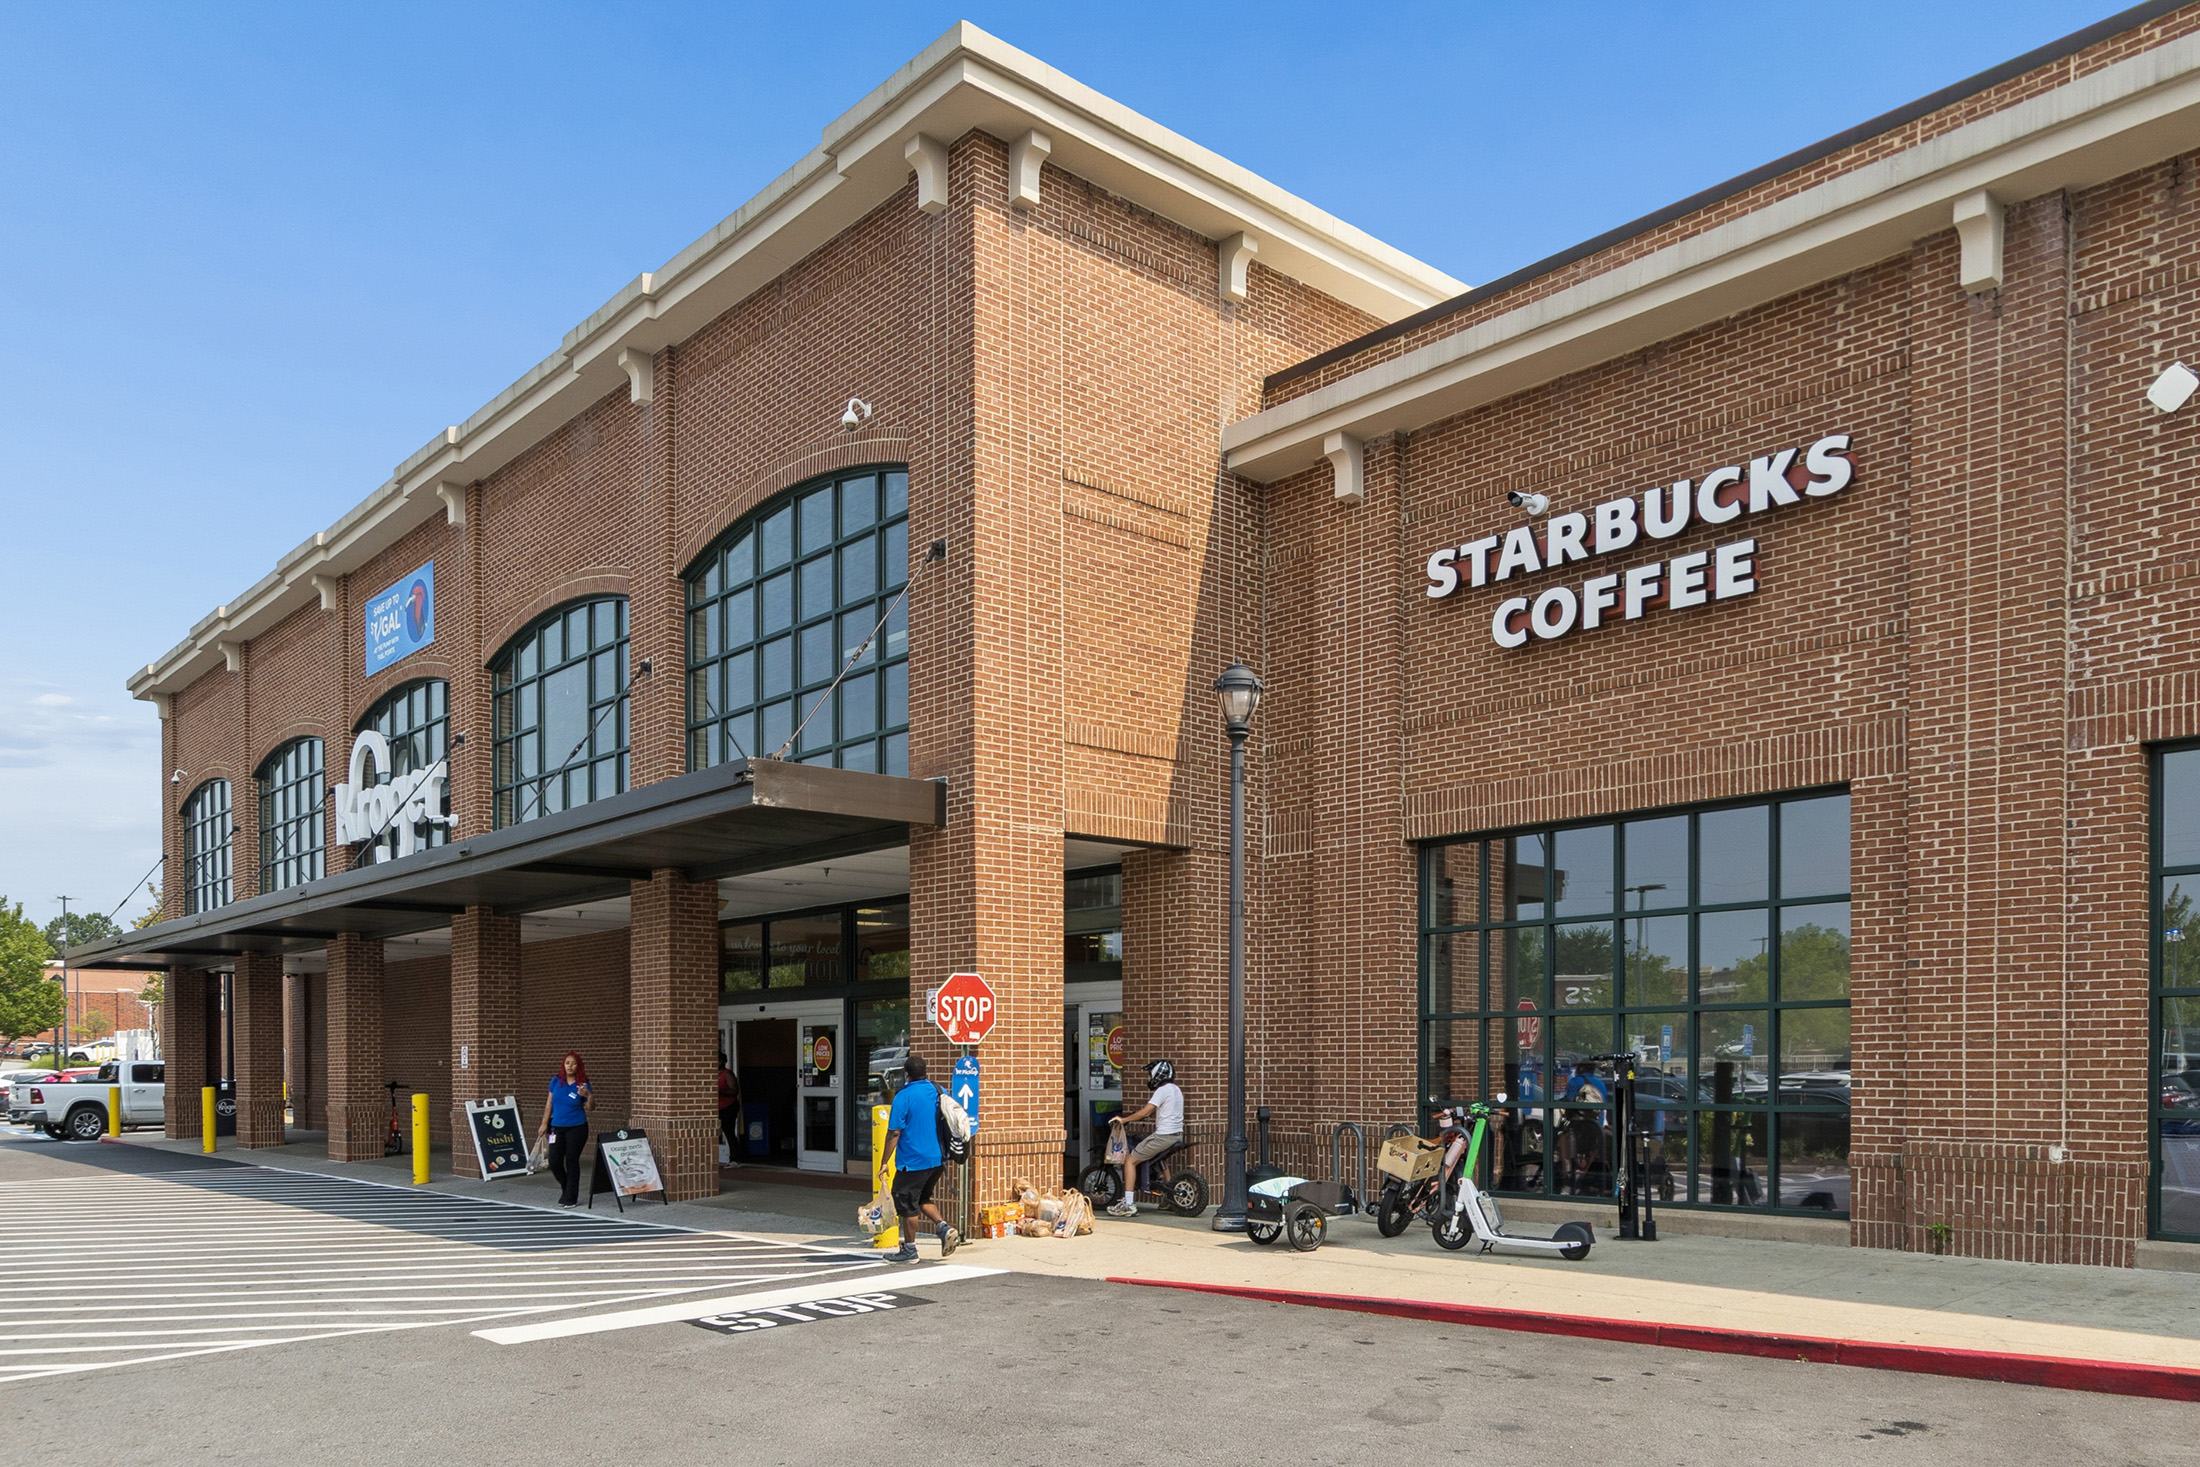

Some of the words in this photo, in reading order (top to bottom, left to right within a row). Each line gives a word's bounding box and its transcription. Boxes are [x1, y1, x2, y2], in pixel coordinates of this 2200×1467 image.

[1426, 434, 1856, 599] STARBUCKS
[1491, 538, 1758, 649] COFFEE
[335, 730, 447, 864] Kroger
[789, 943, 814, 958] your
[816, 940, 841, 955] local
[940, 995, 992, 1022] STOP
[483, 1113, 505, 1129] $6
[486, 1133, 515, 1146] Sushi
[699, 1292, 898, 1331] STOP
